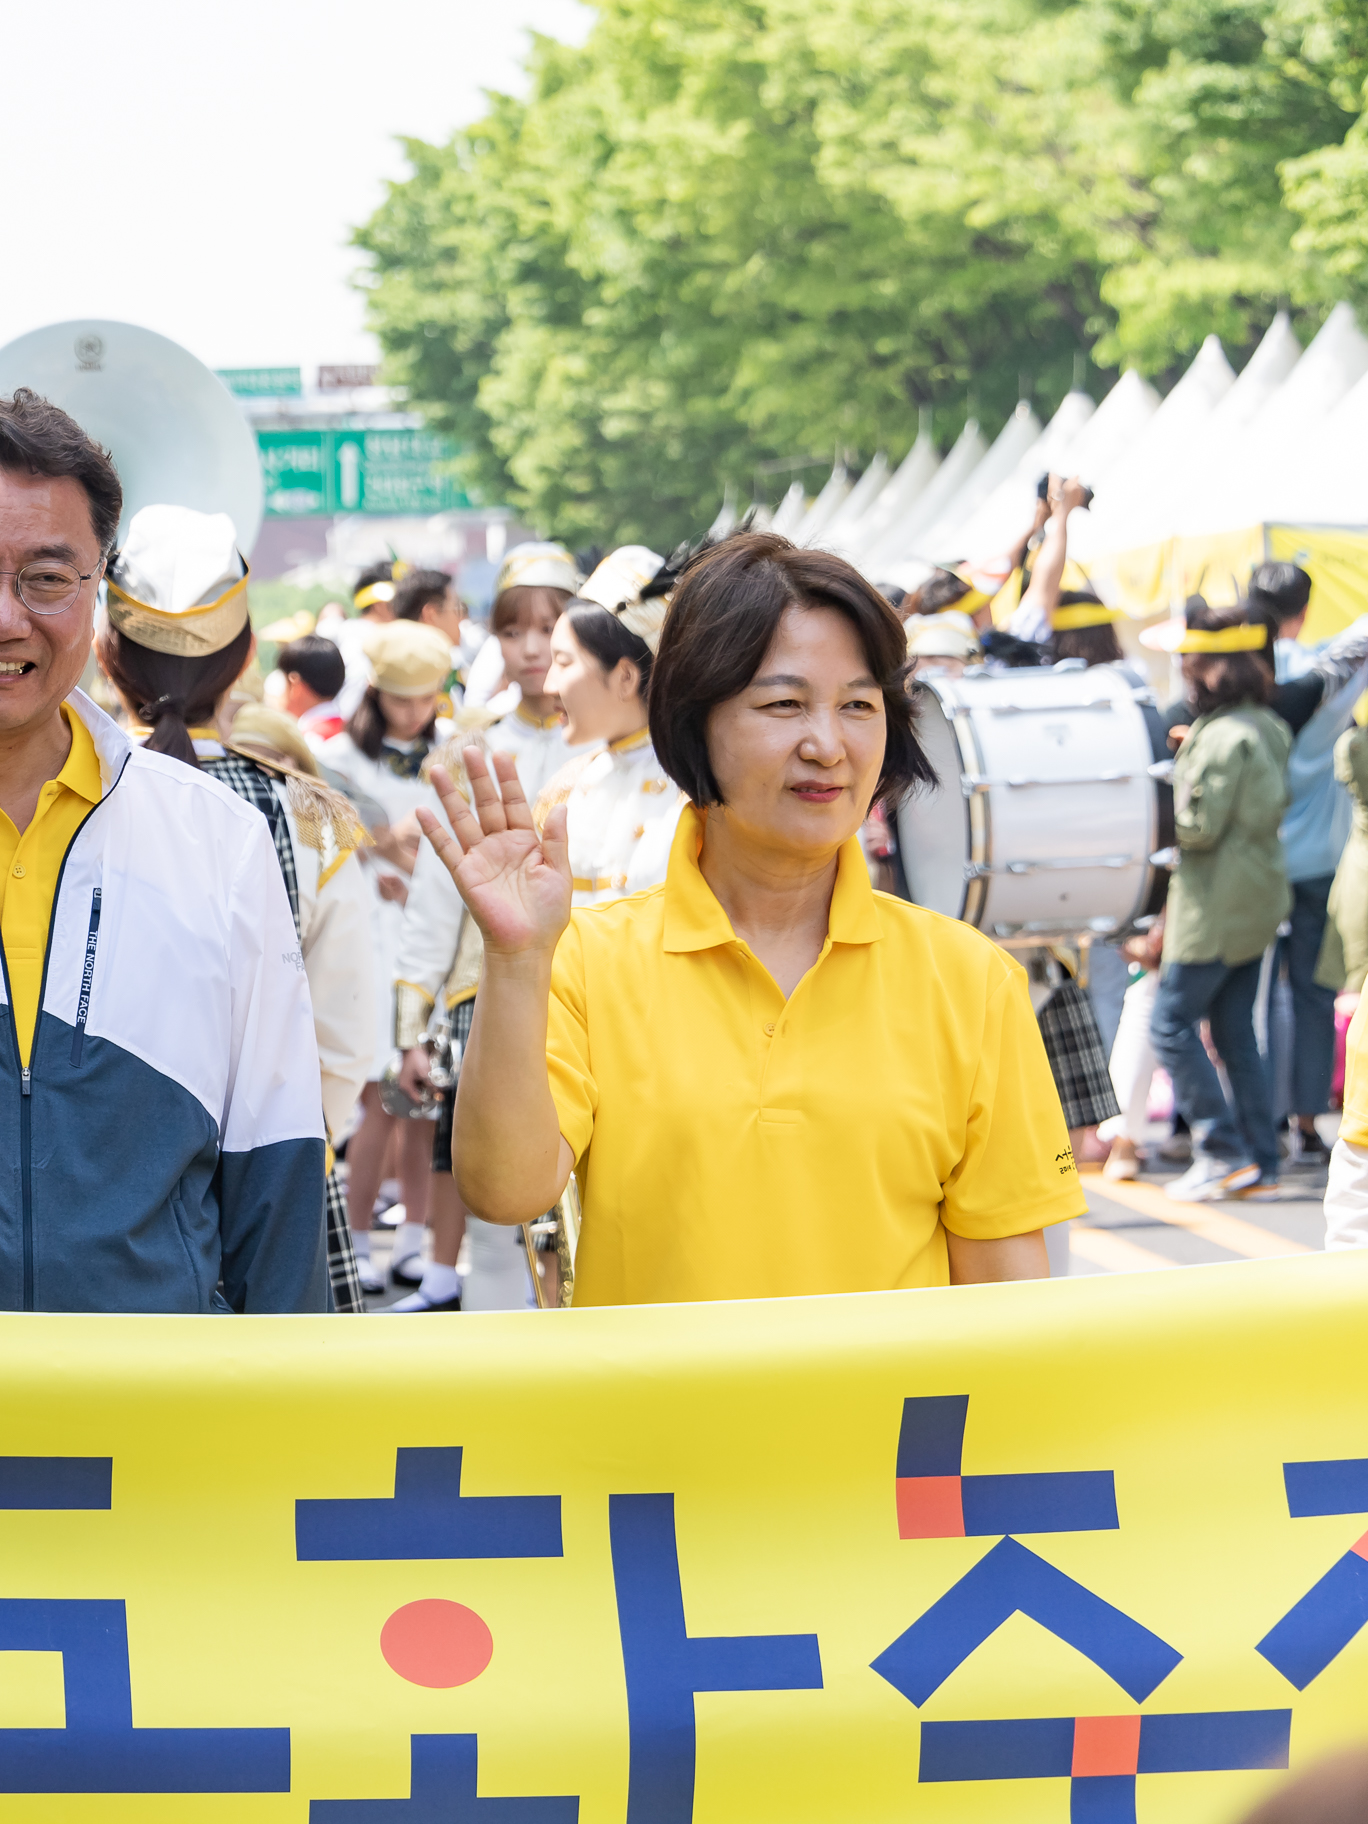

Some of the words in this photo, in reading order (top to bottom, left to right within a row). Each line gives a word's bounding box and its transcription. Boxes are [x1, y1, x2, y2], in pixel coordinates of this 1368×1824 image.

[88, 930, 98, 950] THE
[82, 954, 94, 992] NORTH
[77, 994, 90, 1024] FACE
